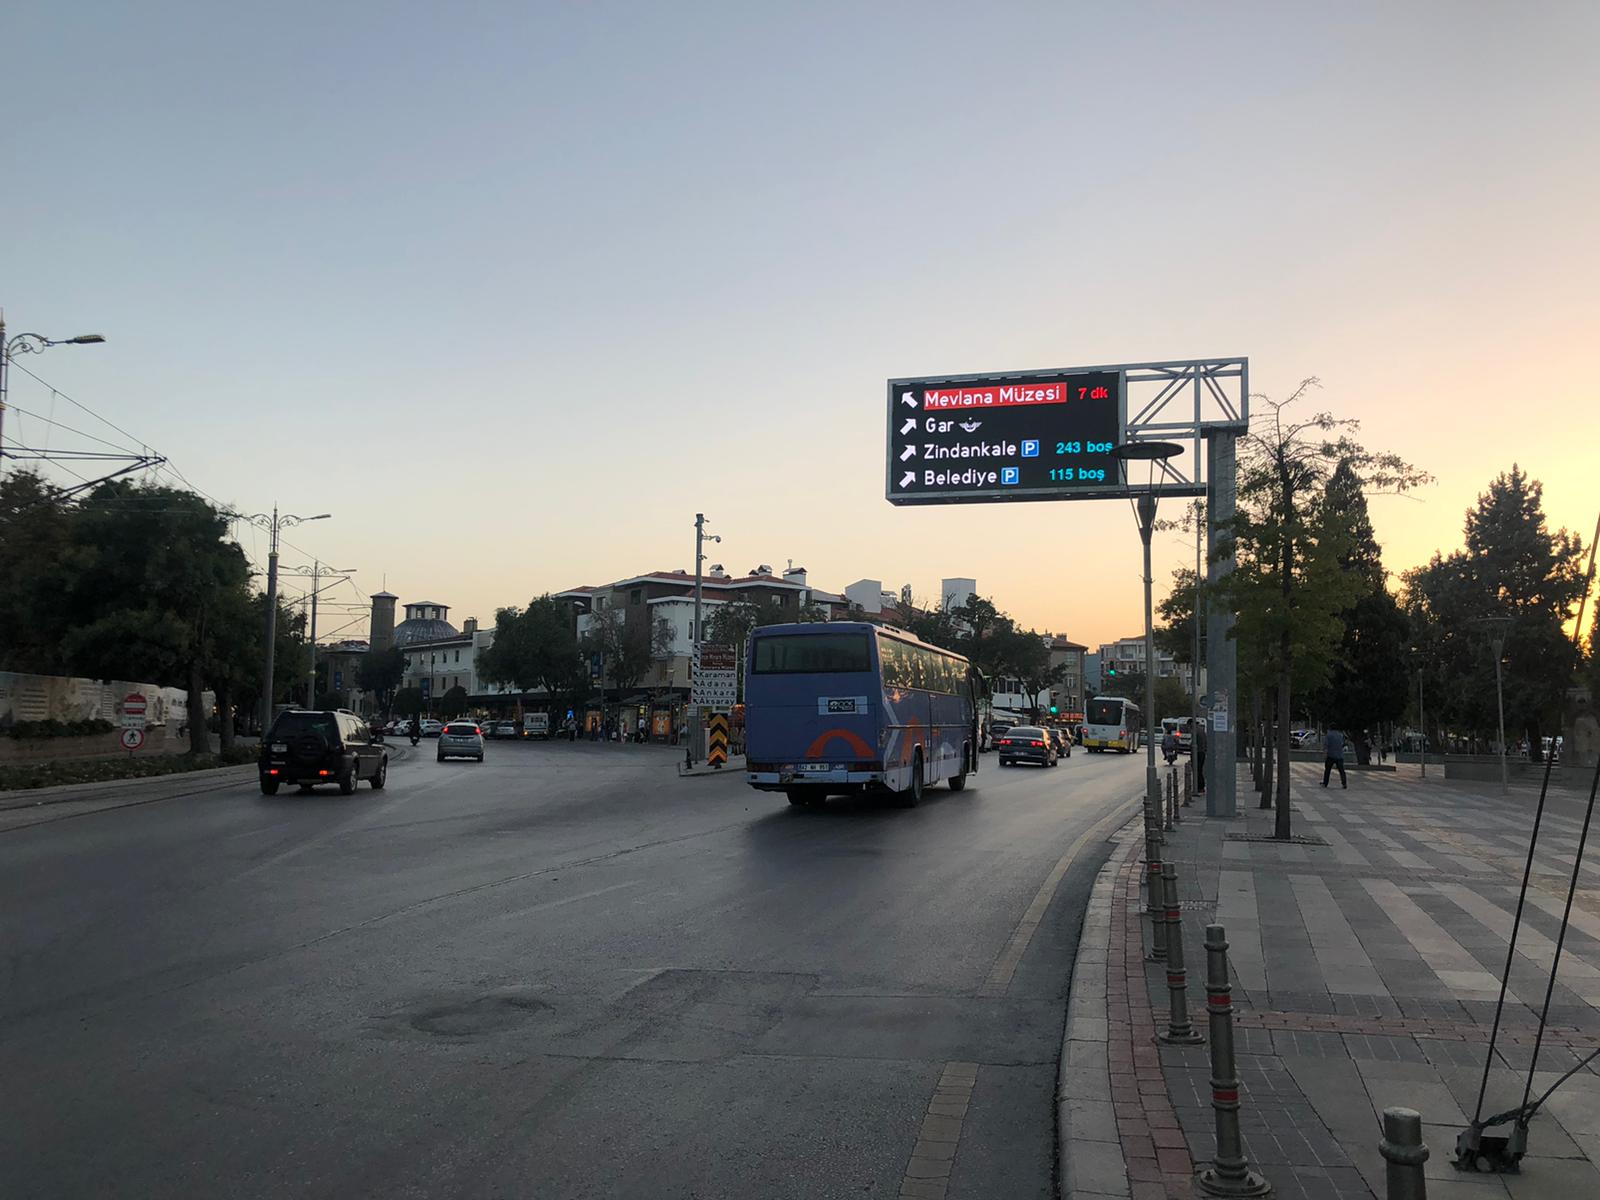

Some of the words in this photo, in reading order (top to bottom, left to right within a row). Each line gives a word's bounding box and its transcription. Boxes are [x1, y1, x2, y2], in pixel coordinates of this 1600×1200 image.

[925, 390, 993, 407] Mevlana
[1000, 385, 1060, 403] Müzesi
[1078, 387, 1087, 400] 7
[1091, 387, 1108, 399] dk
[925, 417, 954, 433] Gar
[924, 440, 1017, 459] Zindankale
[1056, 441, 1081, 454] 243
[1086, 441, 1113, 455] boş
[925, 468, 998, 487] Belediye
[1049, 468, 1074, 481] 115
[1079, 467, 1105, 482] boş
[700, 697, 735, 705] Aksaray
